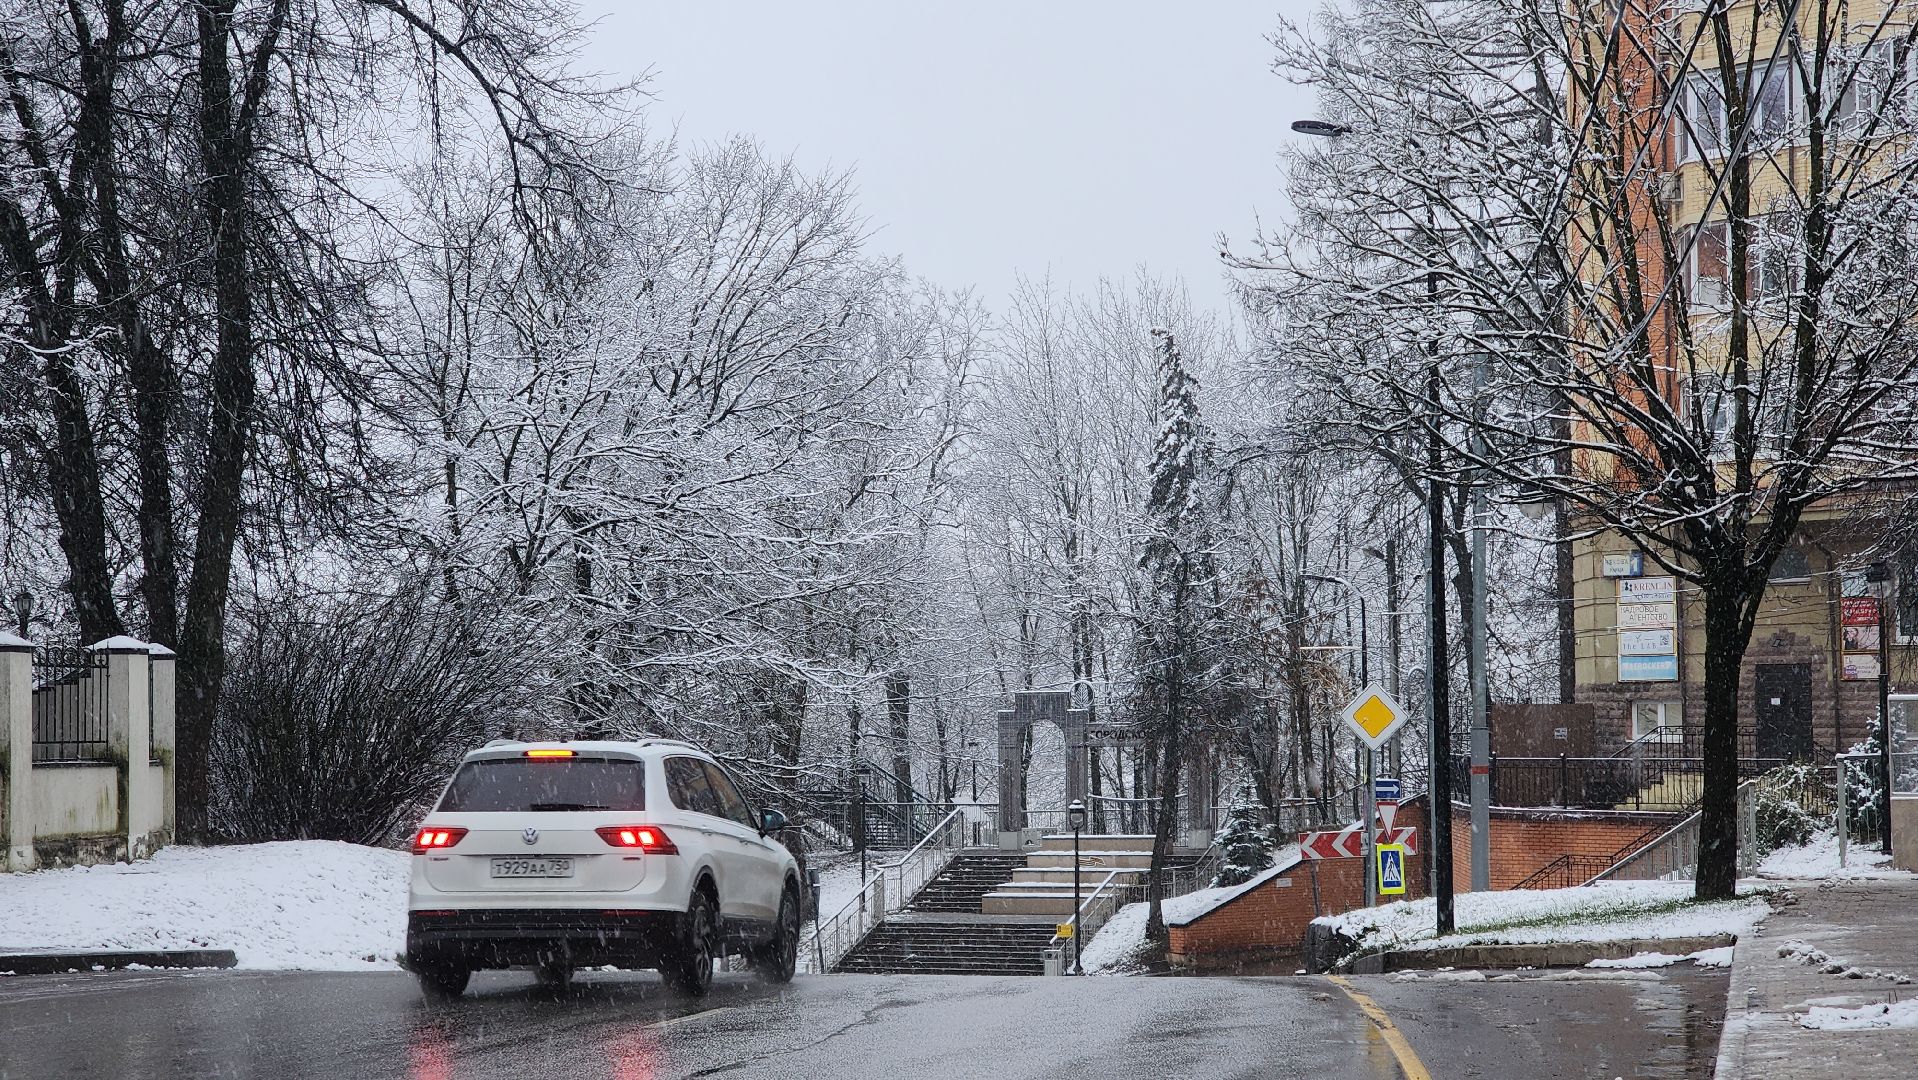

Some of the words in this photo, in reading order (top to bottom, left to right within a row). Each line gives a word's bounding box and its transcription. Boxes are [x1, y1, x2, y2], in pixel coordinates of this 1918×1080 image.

[1630, 557, 1639, 571] 1
[1620, 605, 1659, 614] КАДРОВОЕ
[1629, 613, 1668, 622] АГЕНТСТВО
[1090, 730, 1150, 740] ГОРОДСКО
